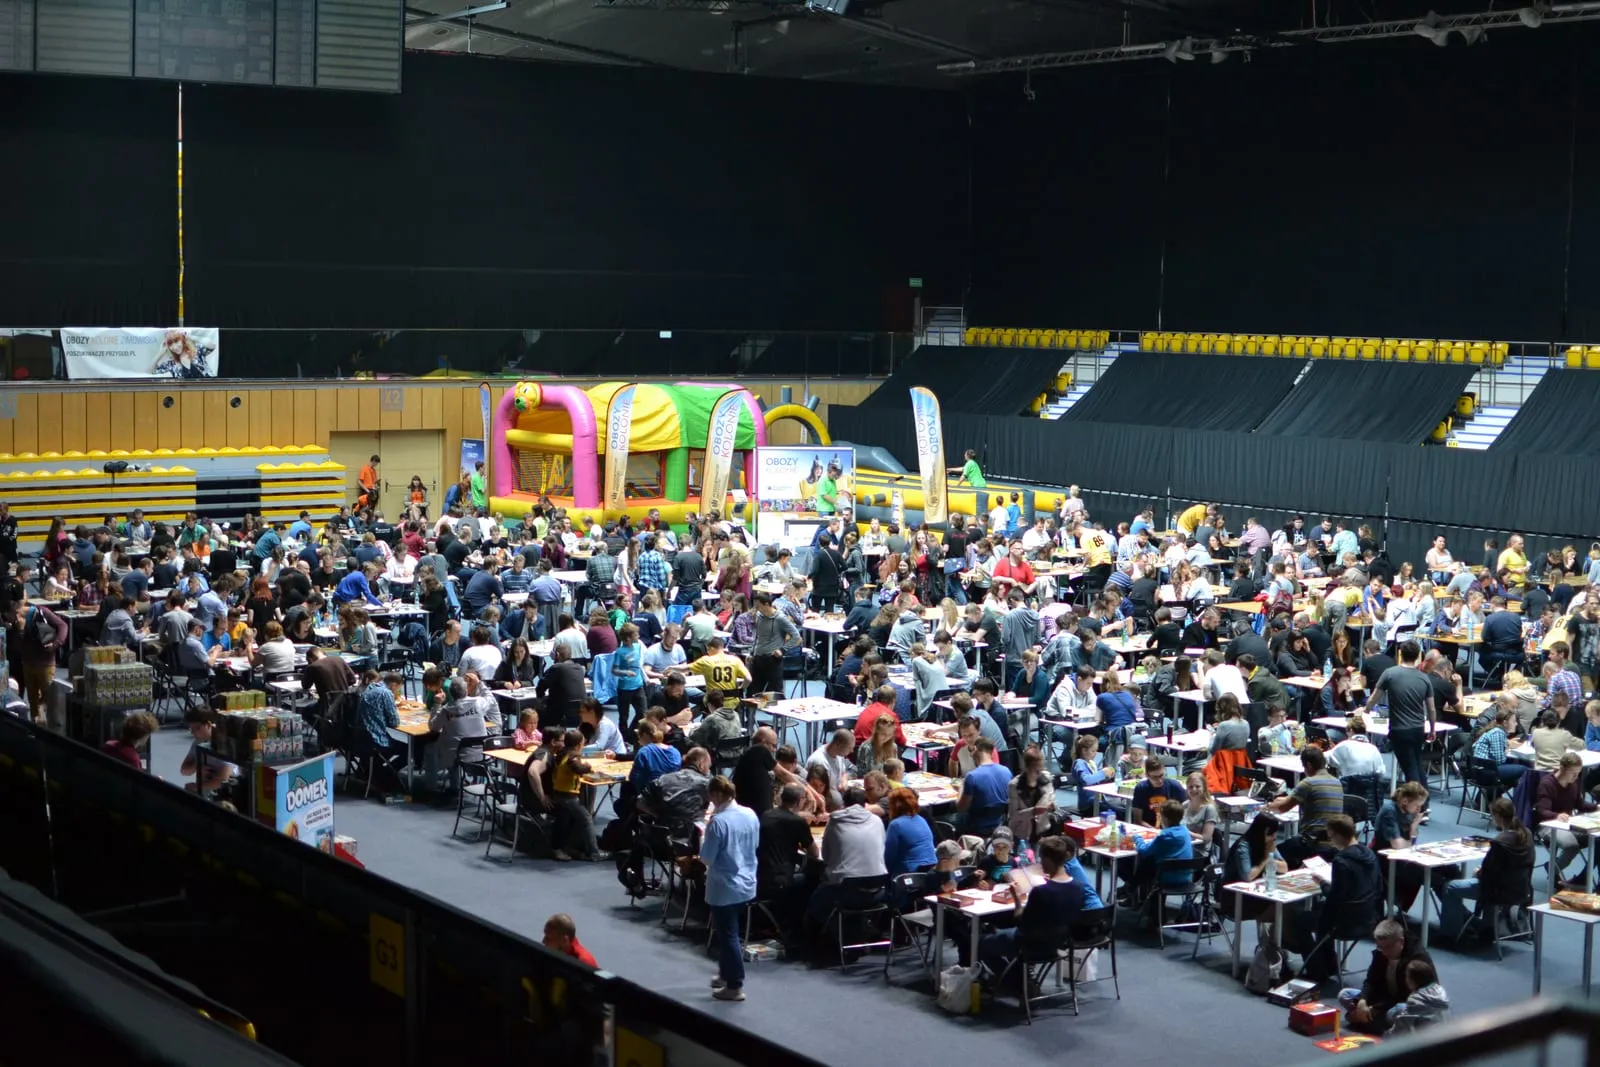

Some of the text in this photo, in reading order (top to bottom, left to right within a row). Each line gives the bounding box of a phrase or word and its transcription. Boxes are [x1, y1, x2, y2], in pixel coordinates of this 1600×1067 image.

[66, 335, 89, 344] OBOZY
[611, 407, 620, 449] OBOZY
[620, 399, 630, 451] KOLONIE
[713, 409, 726, 456] OBOZY
[721, 405, 738, 458] KOLONIE
[765, 457, 799, 466] OBOZY
[712, 665, 733, 683] 03
[286, 778, 328, 812] DOMEK
[374, 936, 399, 972] G3
